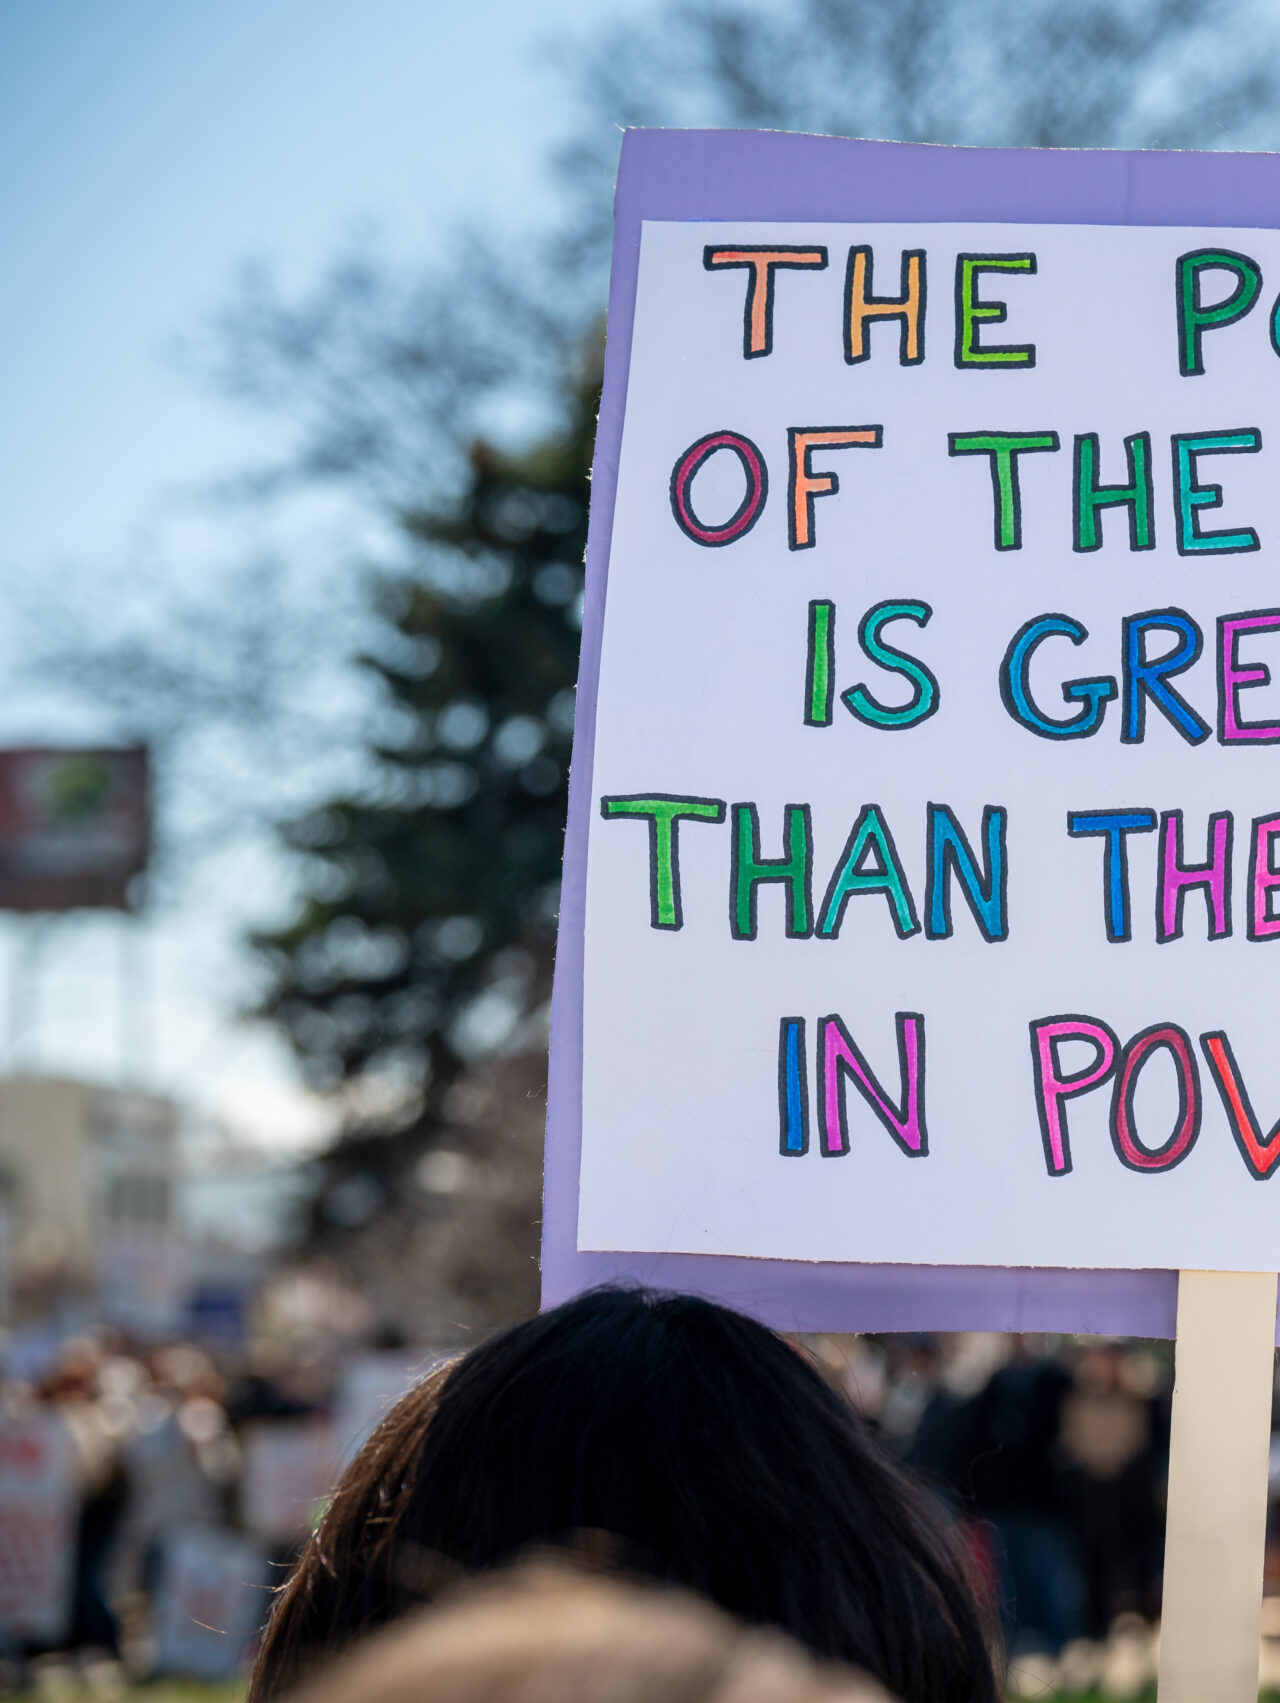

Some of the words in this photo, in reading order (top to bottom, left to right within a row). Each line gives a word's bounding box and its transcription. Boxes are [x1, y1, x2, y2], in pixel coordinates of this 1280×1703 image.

[702, 244, 1037, 370] THE
[669, 424, 884, 552] OF
[947, 427, 1262, 557] THE
[803, 599, 940, 731] IS
[600, 793, 1009, 944] THAN
[778, 1012, 929, 1158] IN
